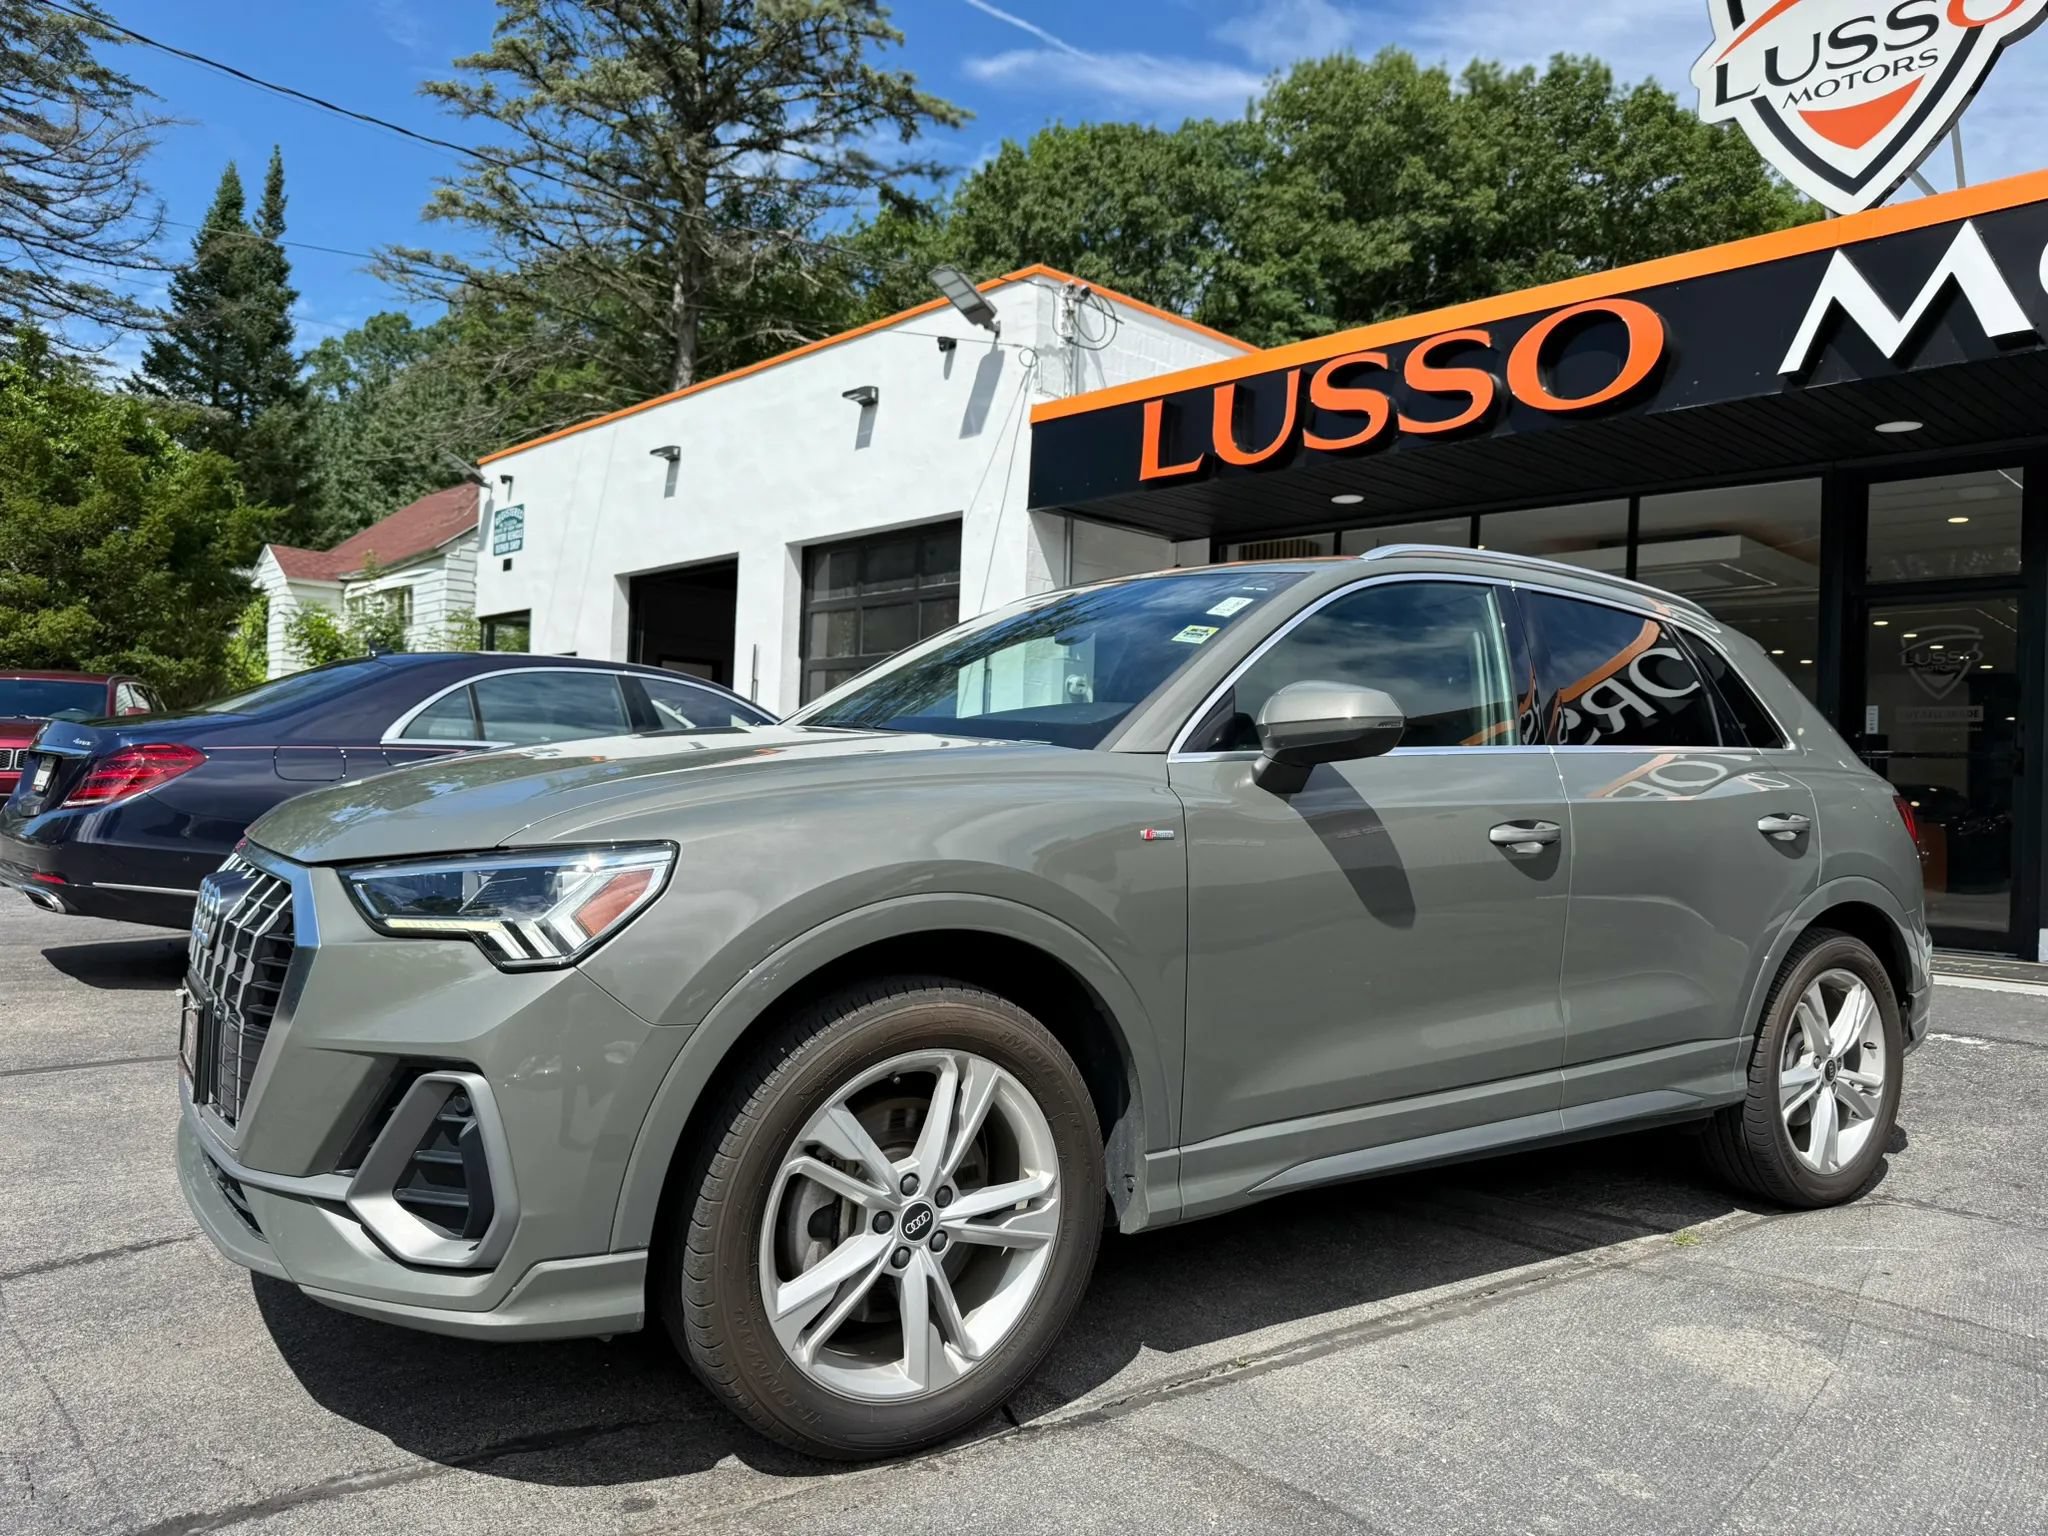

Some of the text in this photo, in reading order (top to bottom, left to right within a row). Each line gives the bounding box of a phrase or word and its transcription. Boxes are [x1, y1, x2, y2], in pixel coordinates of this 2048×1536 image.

[1782, 48, 1938, 109] MOTORS
[1138, 219, 2048, 481] LUSSO M
[1901, 650, 1985, 666] LUSSO
